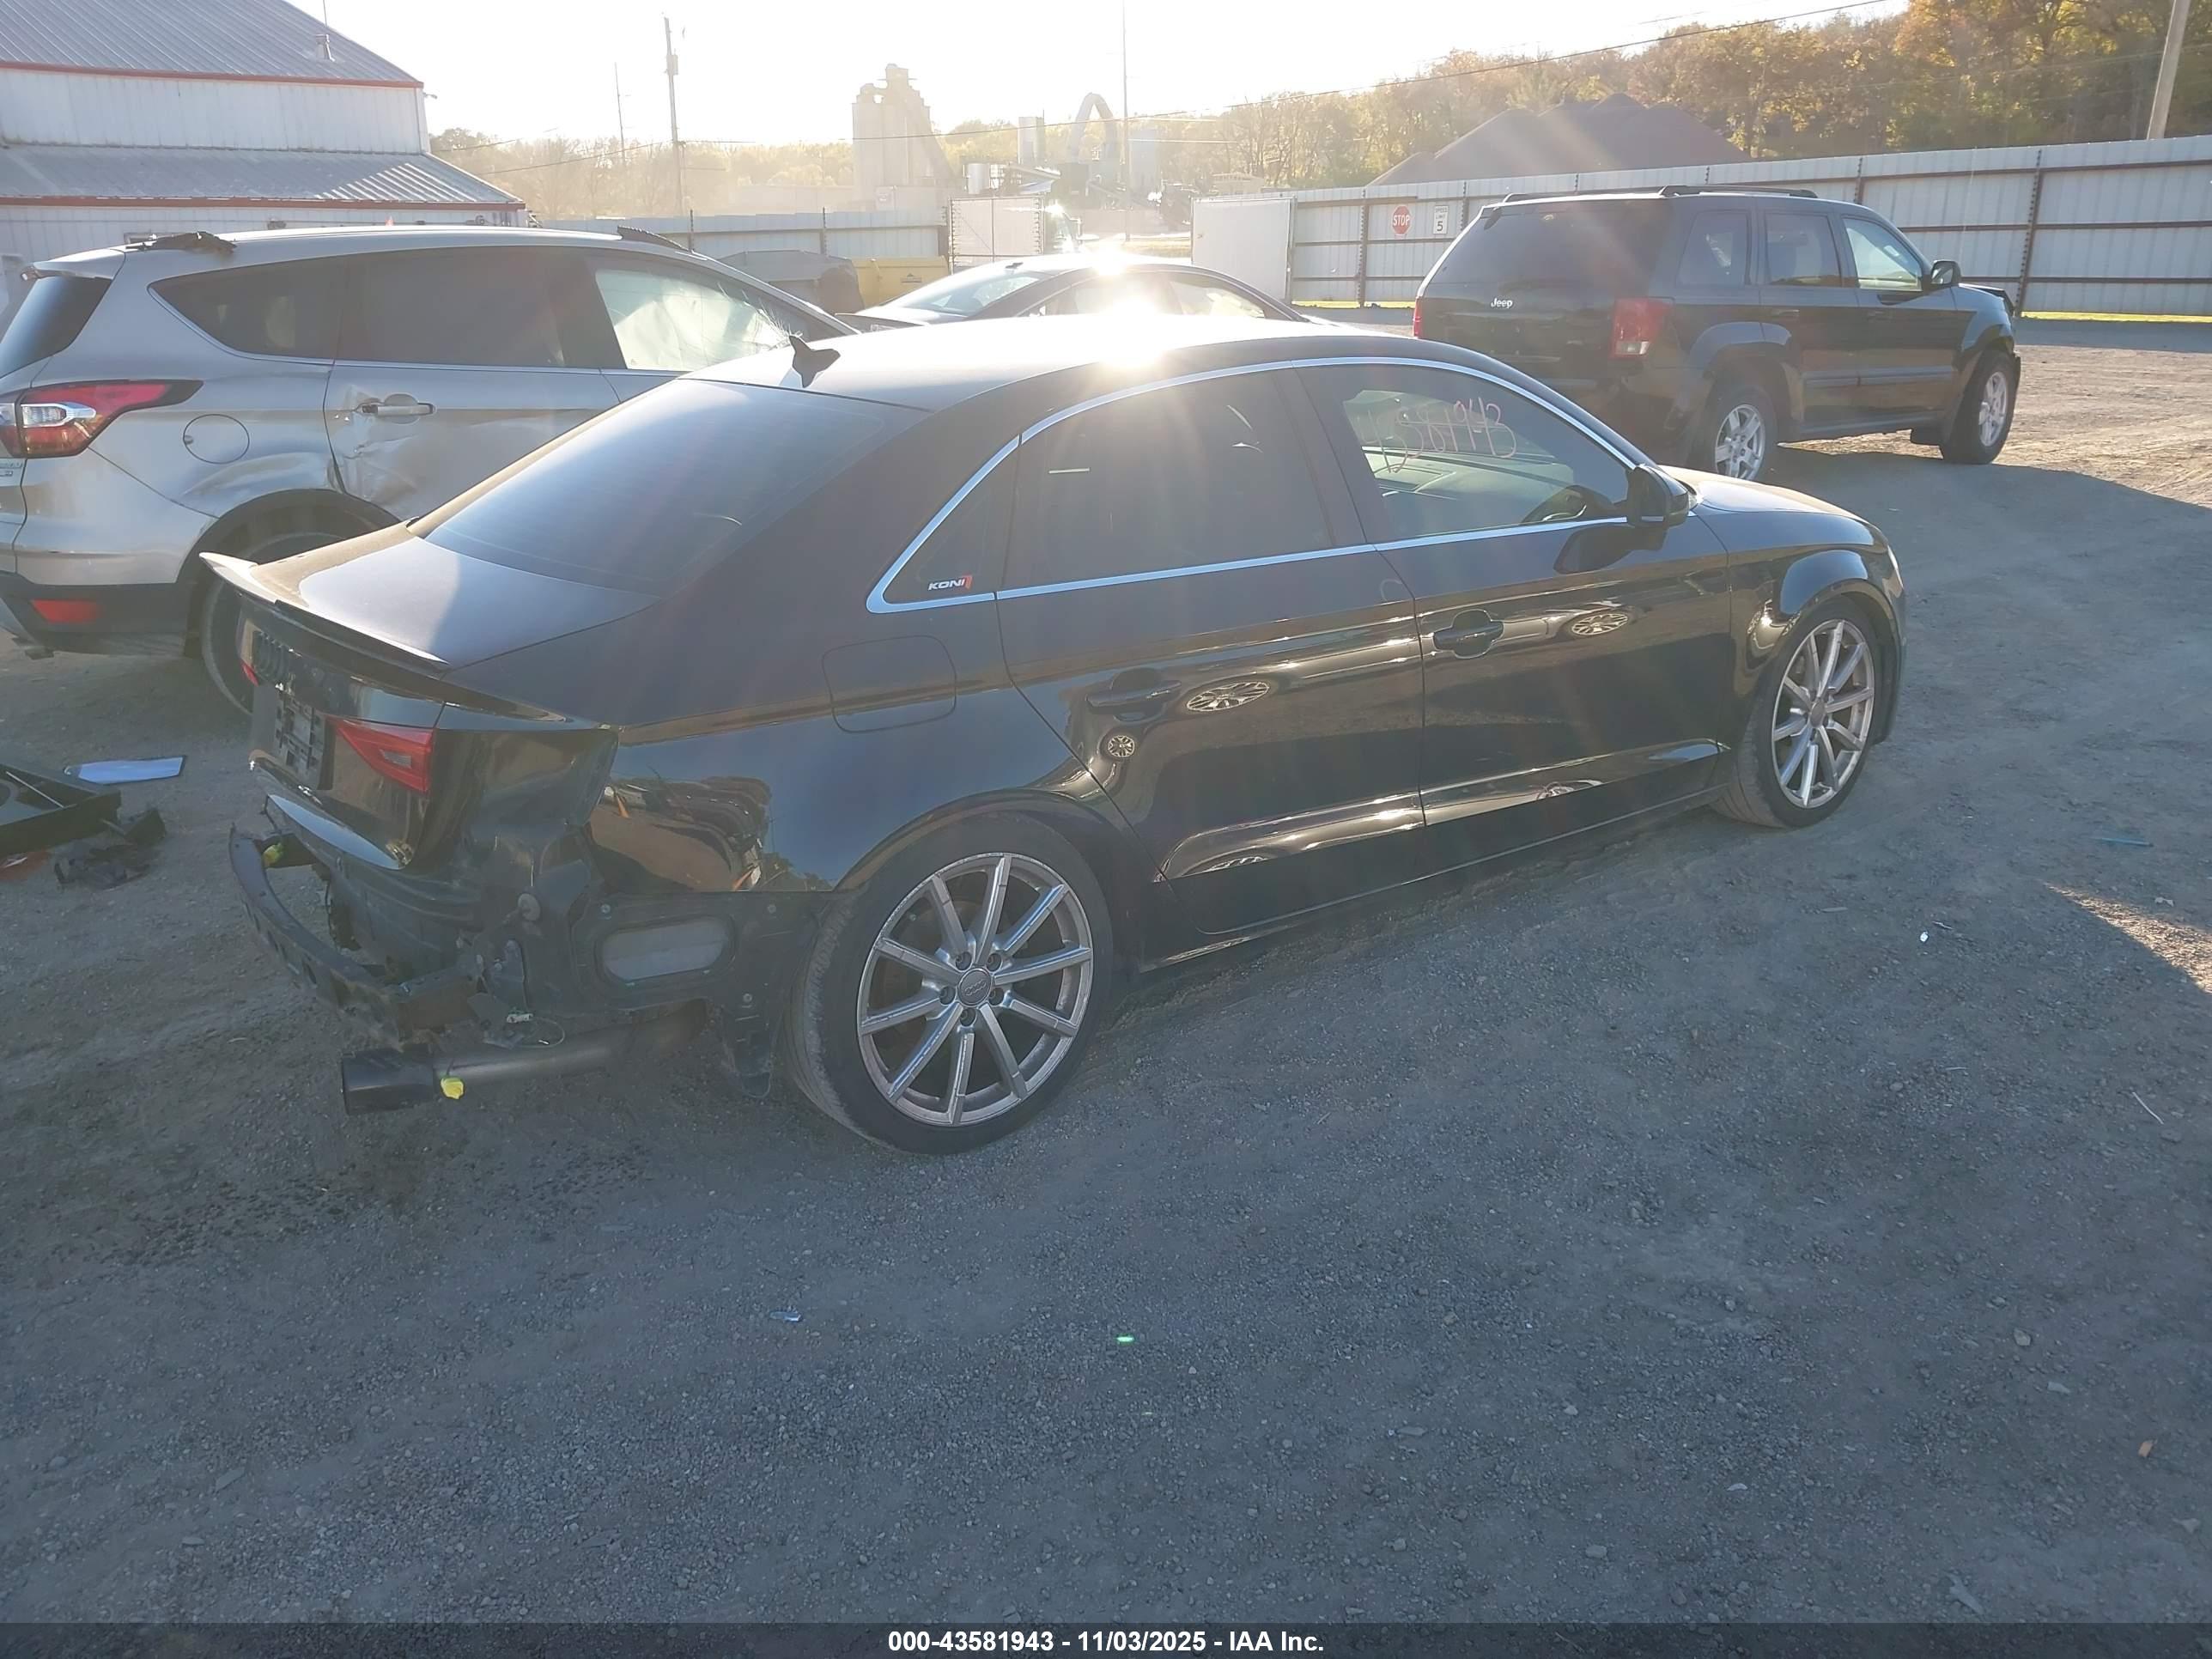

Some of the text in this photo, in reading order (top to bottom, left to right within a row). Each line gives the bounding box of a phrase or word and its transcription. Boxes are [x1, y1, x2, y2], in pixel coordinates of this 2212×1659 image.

[1393, 215, 1410, 226] STOP
[1437, 221, 1443, 232] 5
[1491, 297, 1513, 309] Jeep
[927, 578, 966, 591] KONI
